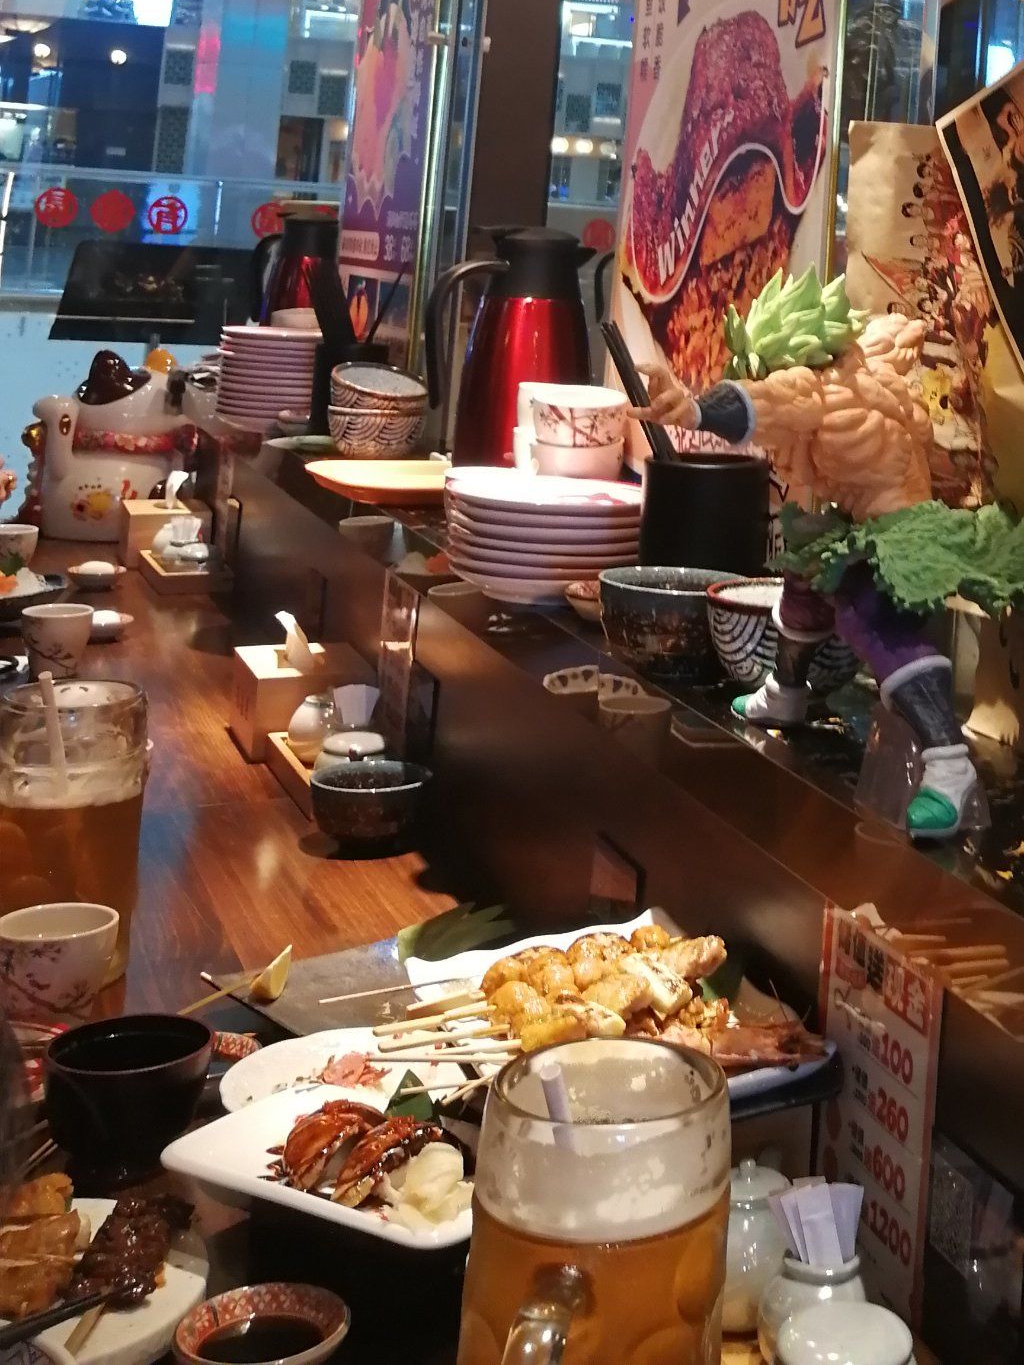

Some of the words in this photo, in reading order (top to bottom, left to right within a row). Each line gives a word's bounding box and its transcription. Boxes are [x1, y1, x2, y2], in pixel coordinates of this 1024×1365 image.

[881, 1031, 914, 1084] 100
[876, 1087, 909, 1145] 260
[873, 1143, 906, 1202] 600
[869, 1199, 913, 1267] 1200
